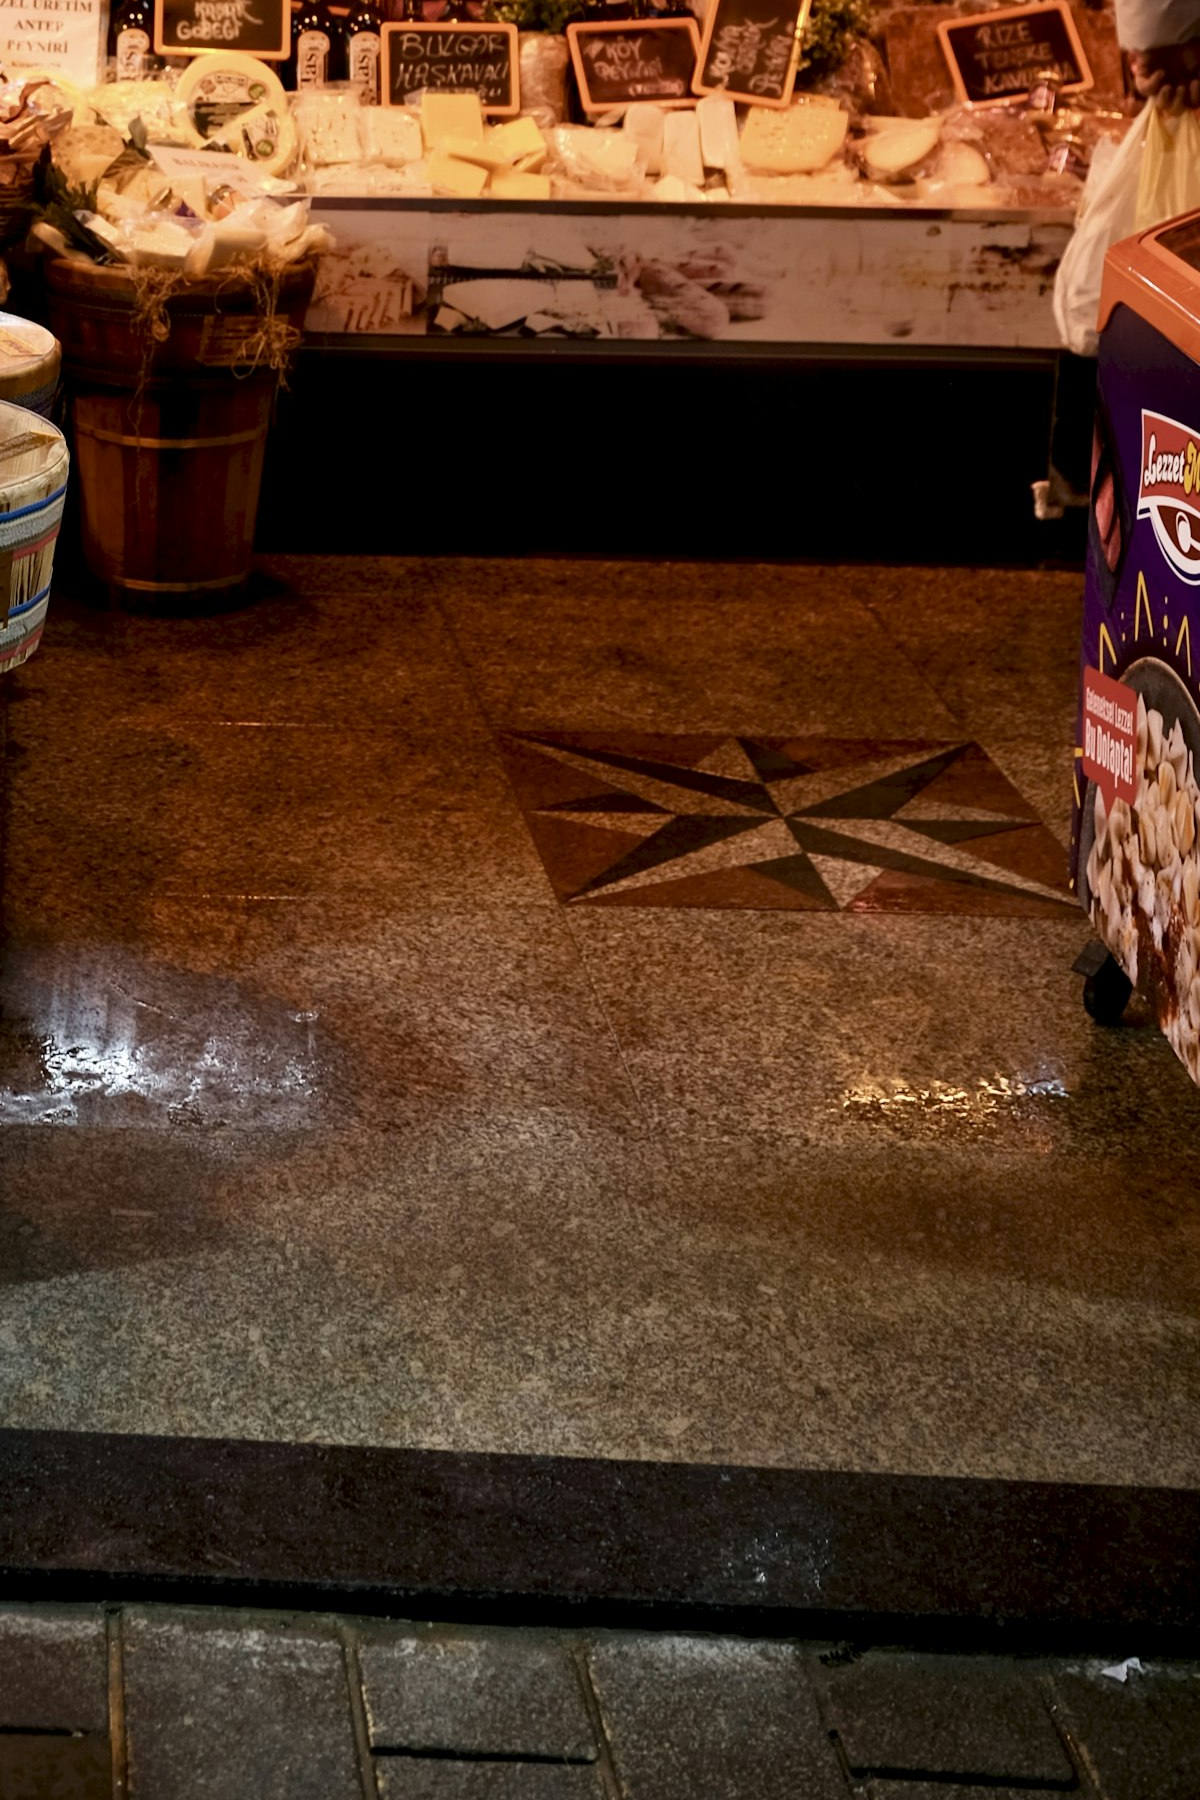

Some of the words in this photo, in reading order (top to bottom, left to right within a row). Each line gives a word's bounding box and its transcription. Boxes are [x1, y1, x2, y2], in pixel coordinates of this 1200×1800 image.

[1114, 702, 1134, 737] Lezzet
[1085, 718, 1096, 762] Bu
[1096, 724, 1134, 789] Dolapta!
